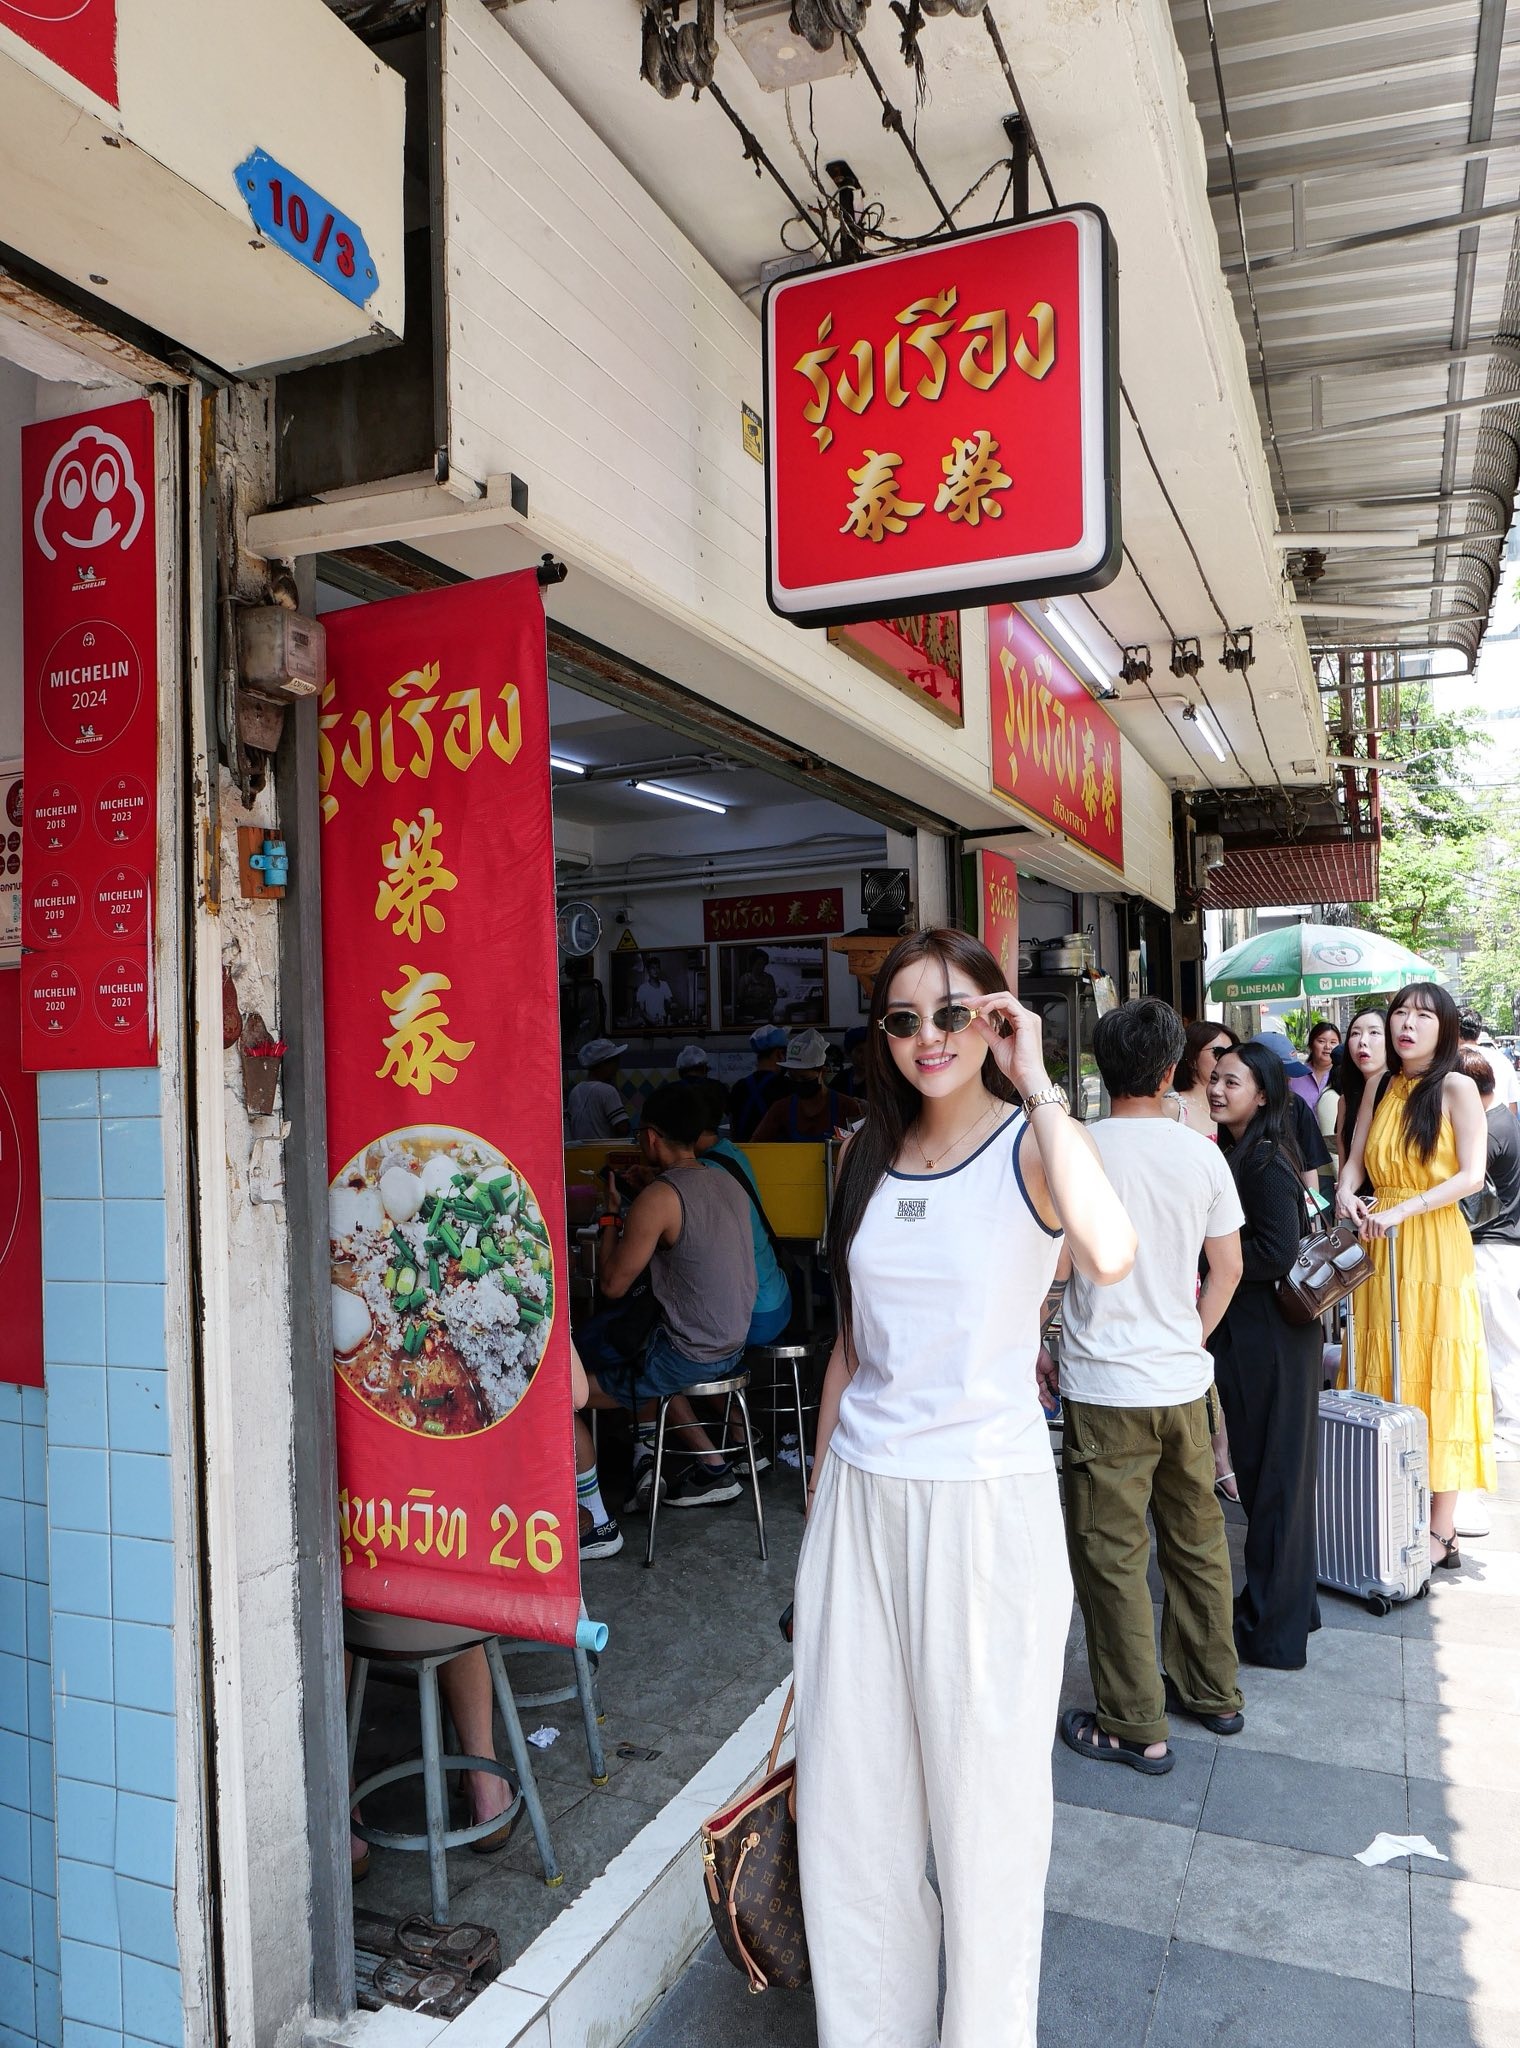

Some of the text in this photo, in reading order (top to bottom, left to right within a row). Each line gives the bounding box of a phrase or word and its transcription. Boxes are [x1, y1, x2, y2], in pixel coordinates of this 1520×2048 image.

[268, 179, 355, 278] 10/3
[793, 284, 1056, 455] รุ่งเรือง
[71, 580, 107, 592] MICHELIN
[50, 660, 129, 688] MICHELIN
[71, 689, 108, 710] 2024
[999, 611, 1077, 795] รุ่งเรือง
[75, 735, 103, 745] MICHELIN
[100, 796, 144, 811] MICHELIN
[35, 804, 77, 818] MICHELIN
[111, 811, 132, 822] 2023
[46, 819, 66, 830] 2018
[34, 895, 76, 908] MICHELIN
[99, 889, 143, 902] MICHELIN
[44, 909, 65, 920] 2019
[110, 903, 131, 915] 2022
[34, 987, 76, 999] MICHELIN
[99, 983, 144, 996] MICHELIN
[45, 1001, 65, 1011] 2020
[111, 997, 131, 1008] 2021
[489, 1503, 563, 1574] 26
